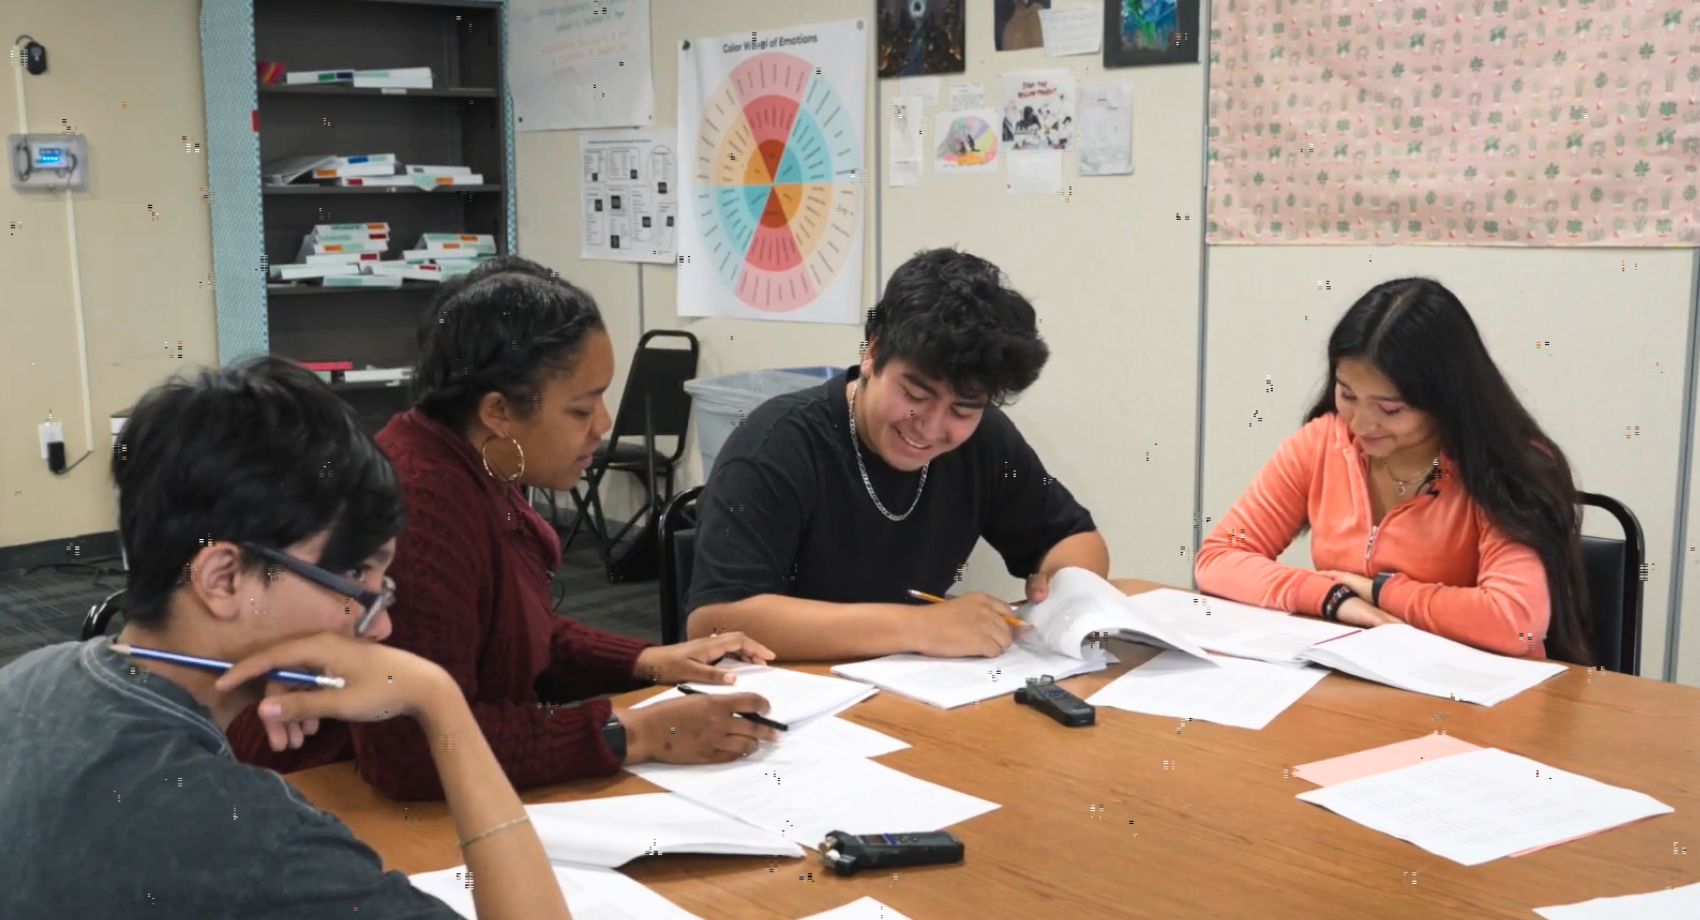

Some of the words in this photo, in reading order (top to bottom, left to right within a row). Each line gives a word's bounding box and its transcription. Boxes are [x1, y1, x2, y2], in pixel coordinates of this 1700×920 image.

[722, 43, 741, 53] Color
[770, 37, 778, 48] of
[779, 34, 818, 46] Emotions
